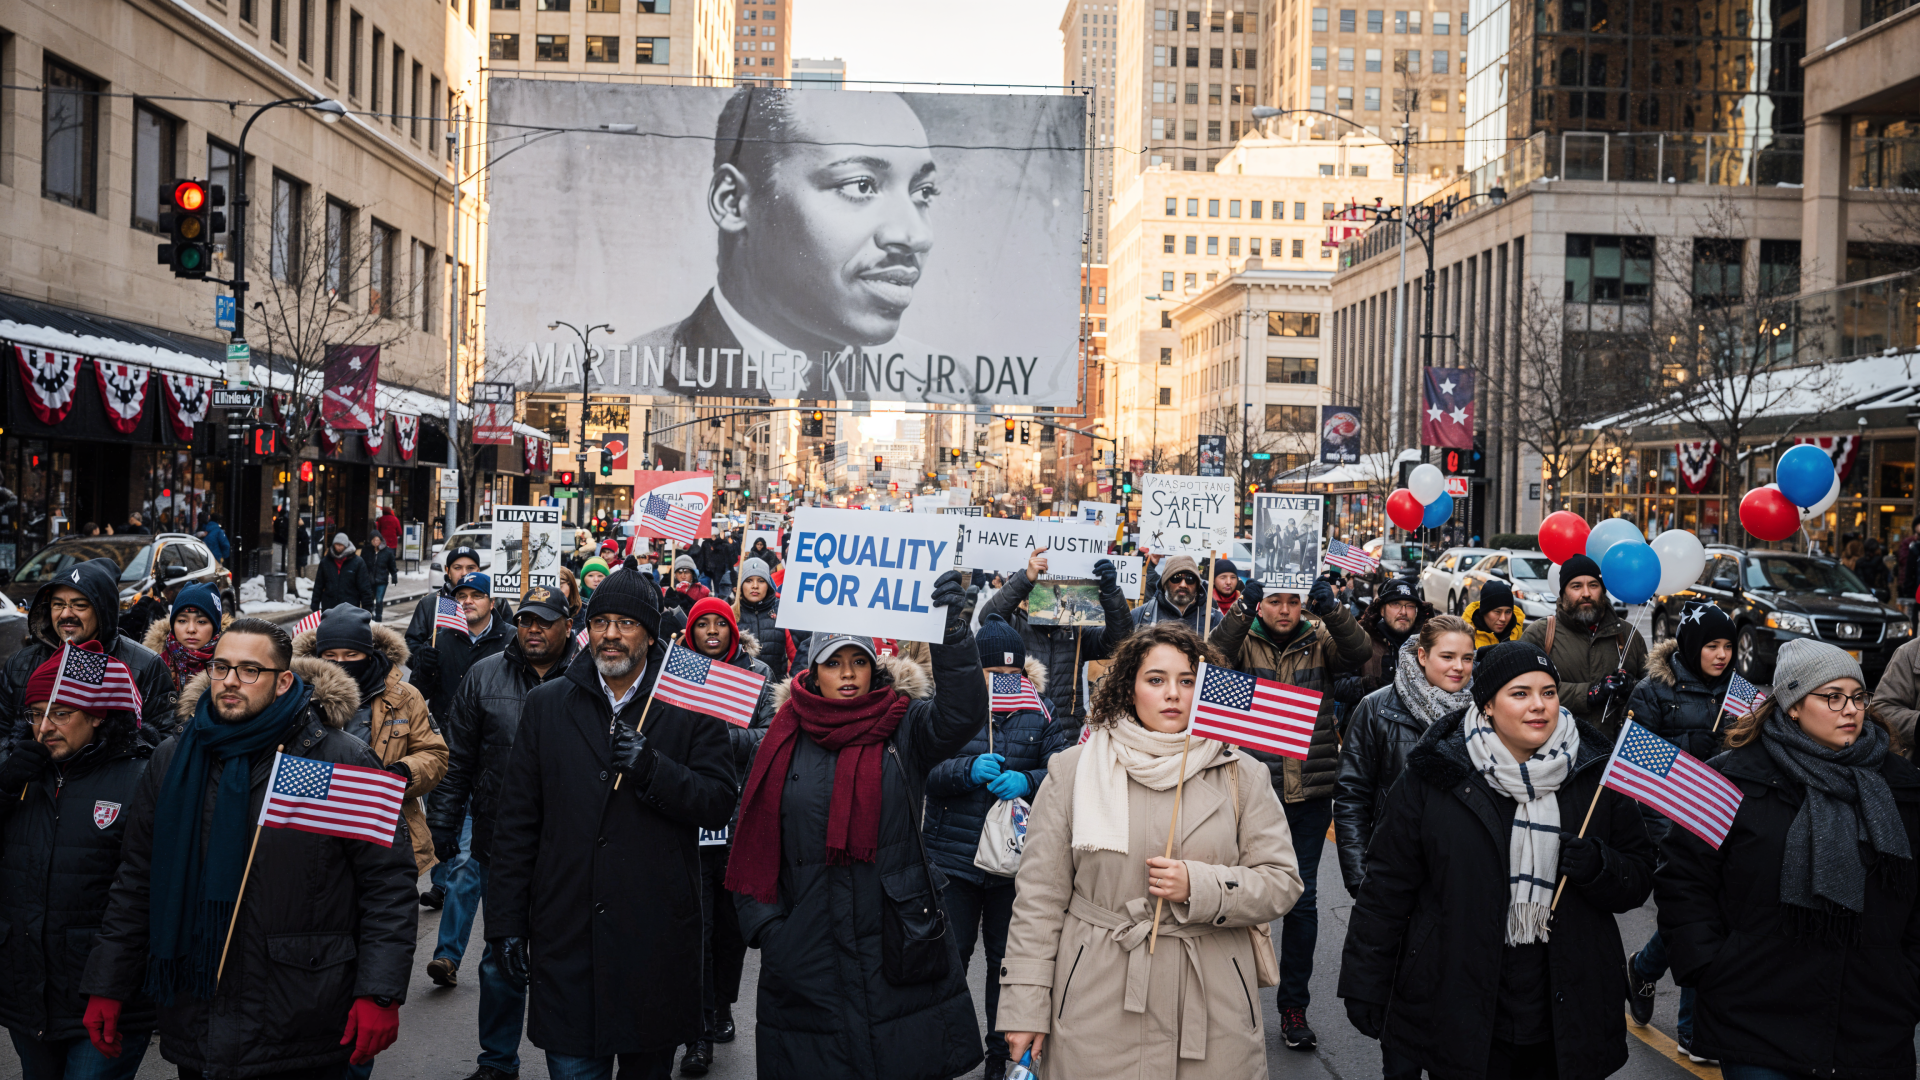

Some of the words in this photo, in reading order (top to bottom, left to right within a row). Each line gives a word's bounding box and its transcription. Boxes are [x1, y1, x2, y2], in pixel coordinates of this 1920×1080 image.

[528, 342, 665, 387] MARTIN
[679, 347, 808, 391] LUTHER
[975, 355, 1038, 396] DAY
[795, 532, 948, 571] EQUALITY
[978, 530, 1019, 548] HAVE
[797, 572, 860, 607] FOR
[867, 577, 929, 613] ALL
